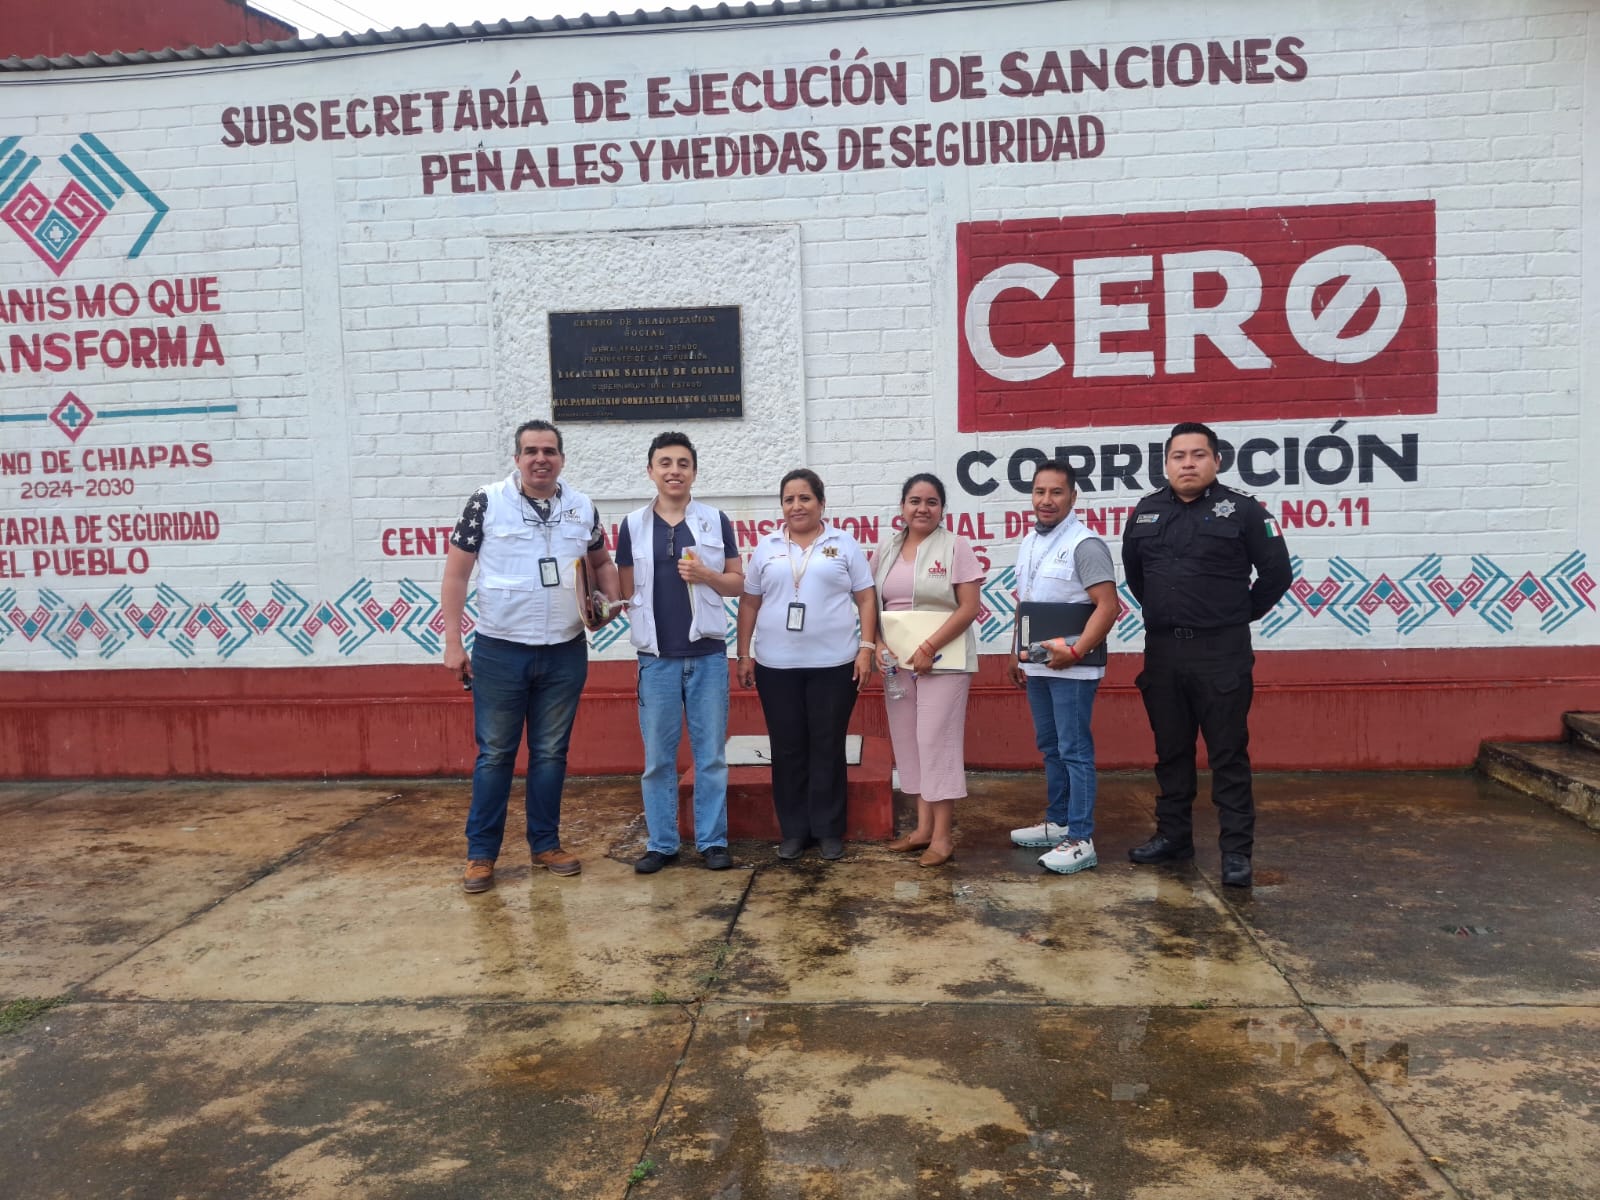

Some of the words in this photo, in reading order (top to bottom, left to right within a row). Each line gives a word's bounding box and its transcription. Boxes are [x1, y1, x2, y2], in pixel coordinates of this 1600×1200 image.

[221, 71, 548, 147] SUBSECRETARÍA
[574, 80, 630, 122] DE
[930, 55, 987, 102] DE
[999, 37, 1308, 97] SANCIONES
[421, 141, 624, 194] PENALES
[629, 139, 656, 182] Y
[662, 132, 827, 181] MEDIDAS
[838, 126, 884, 170] DE
[890, 115, 1105, 168] SEGURIDAD
[148, 276, 221, 318] QUE
[0, 324, 224, 374] NSFORMA
[0, 452, 31, 475] NO
[42, 450, 73, 474] DE
[82, 443, 213, 473] CHIAPAS
[21, 478, 135, 499] 2024-2030
[75, 515, 103, 544] DE
[108, 511, 220, 542] SEGURIDAD
[382, 527, 453, 556] CENT
[1282, 496, 1370, 529] NO.11
[33, 547, 149, 577] PUEBLO
